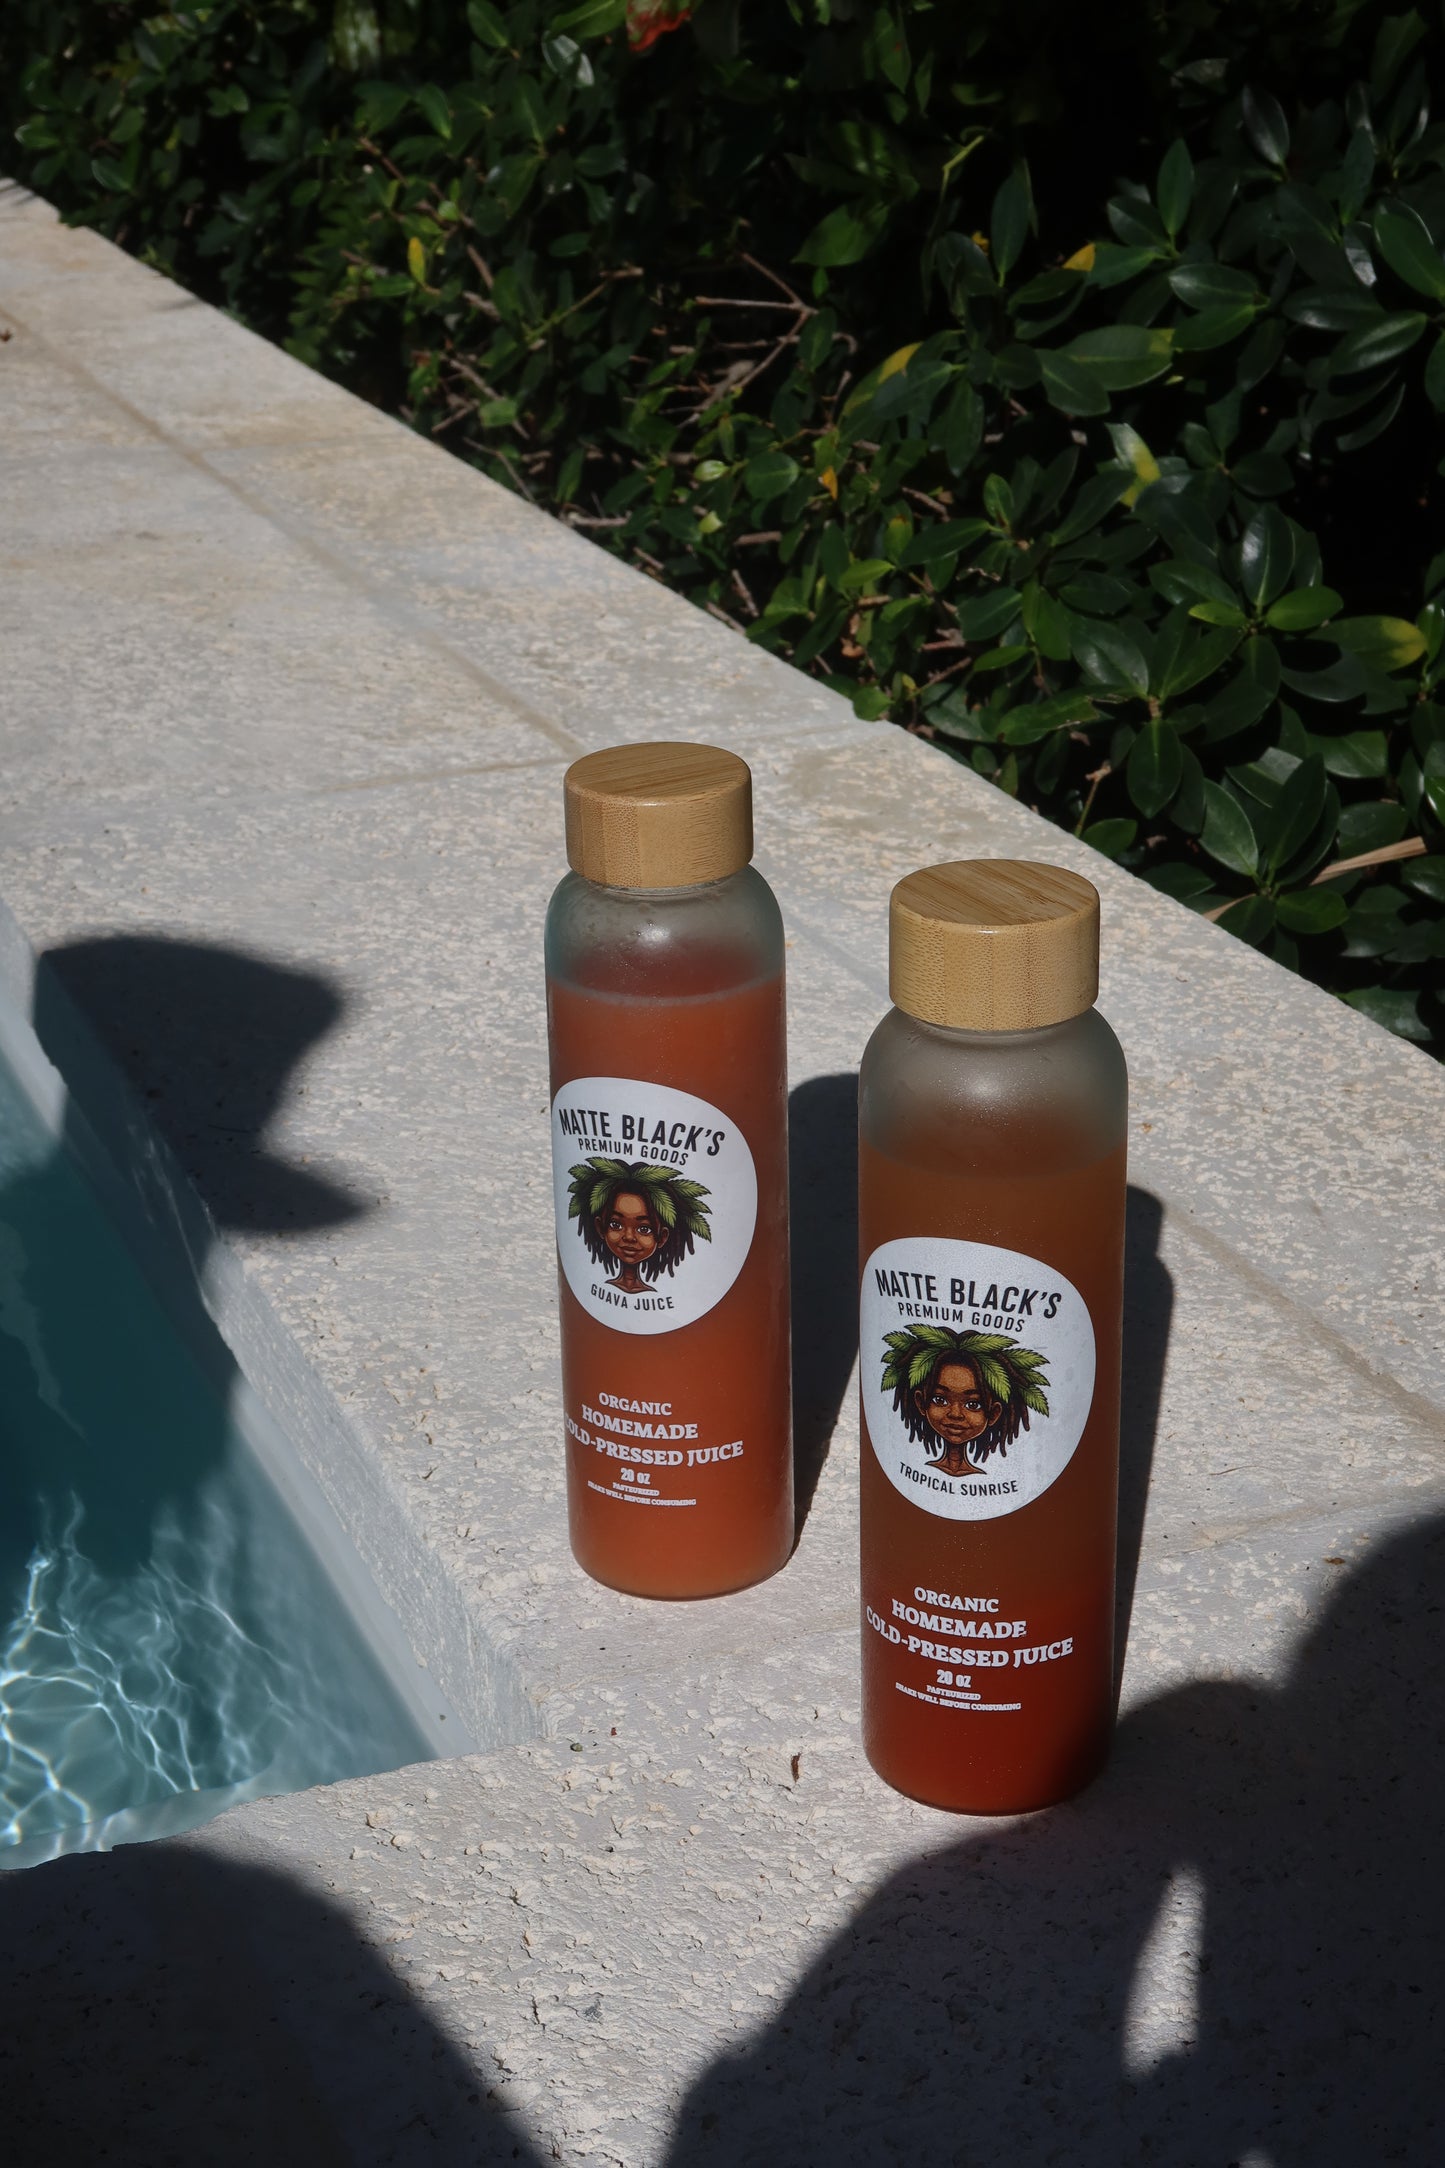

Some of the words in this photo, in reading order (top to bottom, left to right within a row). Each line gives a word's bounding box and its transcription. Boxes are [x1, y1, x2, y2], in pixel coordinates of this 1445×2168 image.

[559, 1108, 612, 1138] MATTE
[622, 1114, 726, 1156] BLACK'S
[578, 1137, 633, 1156] PREMIUM
[641, 1145, 689, 1165] GOODS
[590, 1284, 628, 1309] GUAVA
[634, 1296, 674, 1311] JUICE
[875, 1269, 939, 1303] MATTE
[950, 1278, 1062, 1319] BLACK'S
[898, 1302, 963, 1323] PREMIUM
[971, 1312, 1025, 1333] GOODS
[598, 1392, 672, 1416] ORGANIC
[581, 1403, 698, 1440] HOMEMADE
[686, 1440, 744, 1468] JUICE
[620, 1467, 634, 1482] 20
[900, 1461, 955, 1495] TROPICAL
[960, 1480, 1018, 1496] SUNRISE
[914, 1586, 999, 1613] ORGANIC
[892, 1598, 1027, 1639] HOMEMADE
[866, 1605, 1009, 1667] COLD-PRESSED
[1013, 1637, 1073, 1668] JUICE
[936, 1669, 953, 1685] 20
[955, 1674, 971, 1688] OZ
